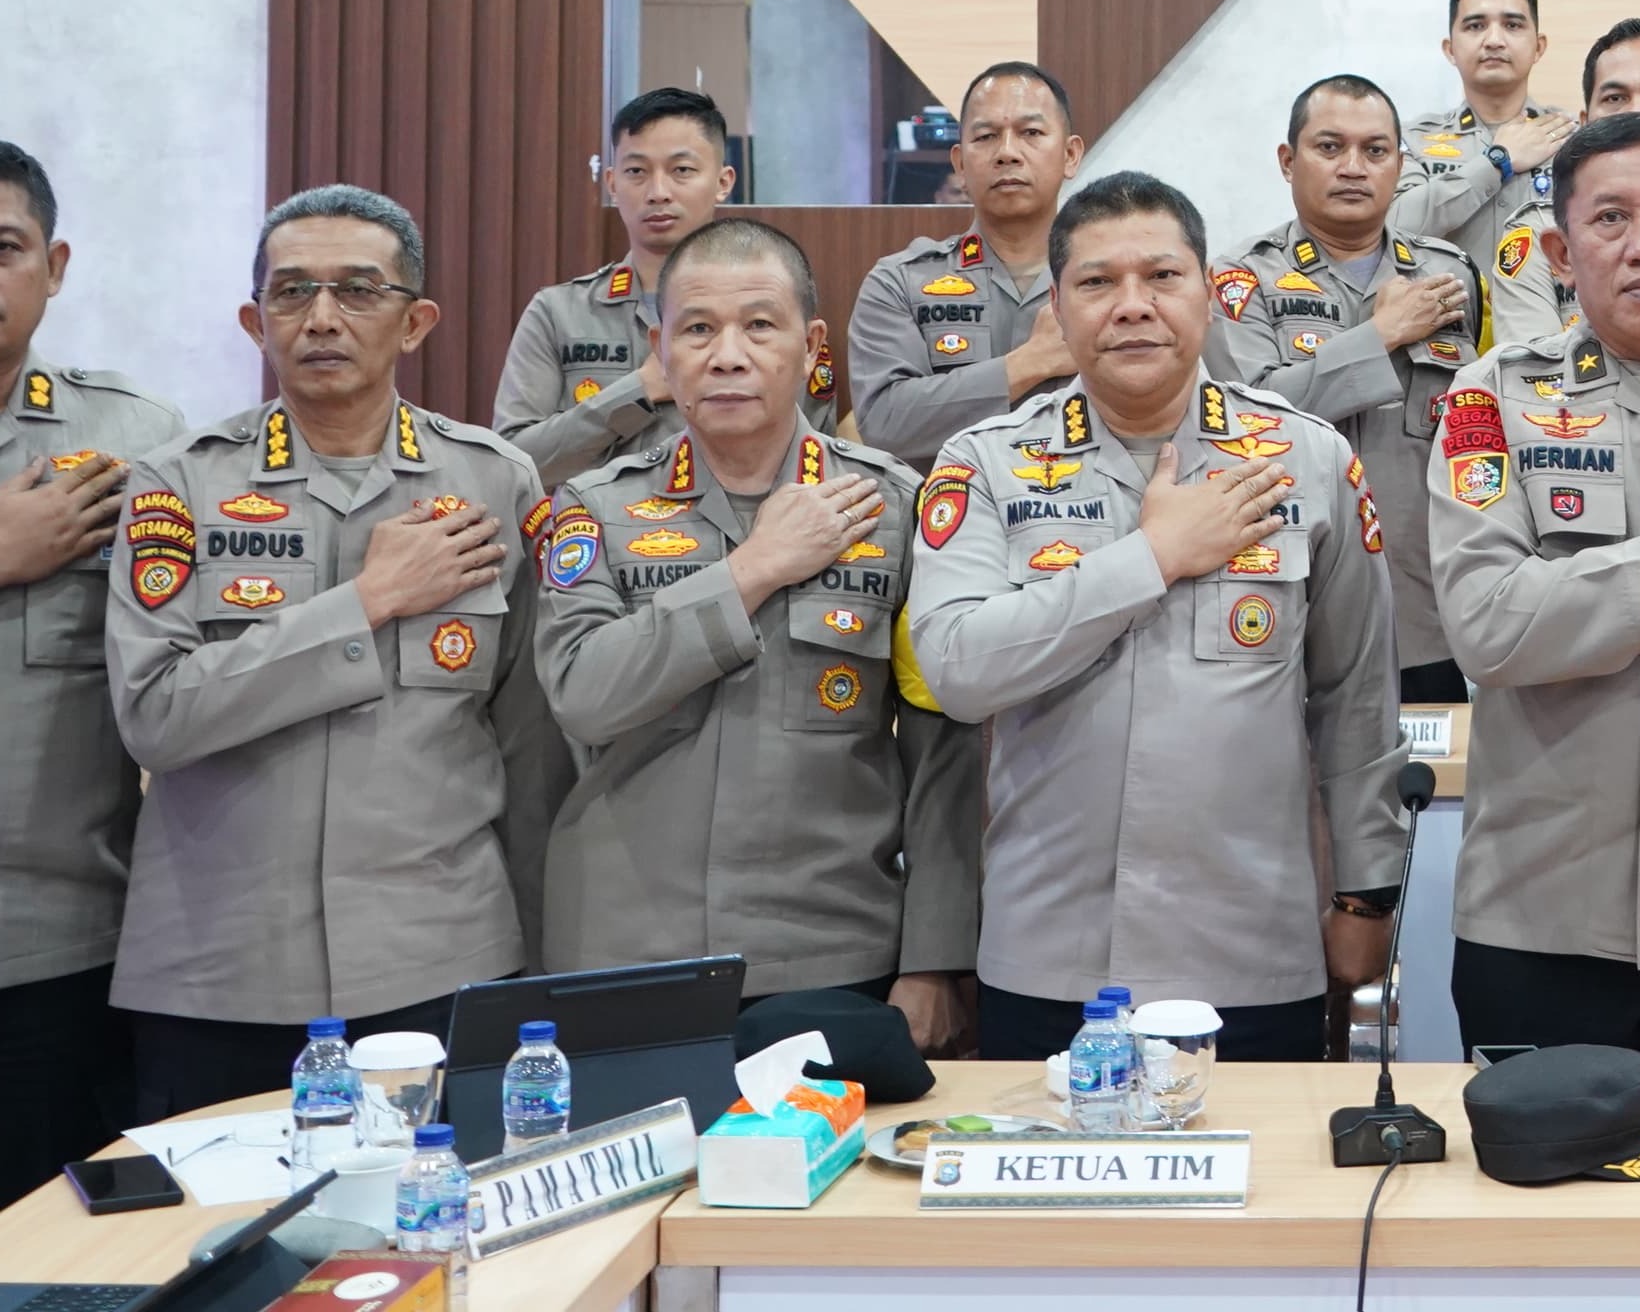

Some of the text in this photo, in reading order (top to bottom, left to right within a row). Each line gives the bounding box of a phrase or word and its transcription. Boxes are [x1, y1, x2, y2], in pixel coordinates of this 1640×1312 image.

[918, 304, 985, 325] ROBET
[1450, 410, 1504, 427] GEGAN
[1447, 433, 1508, 452] PELOPO
[1518, 445, 1615, 473] HERMAN
[1007, 499, 1105, 528] MIRZAL ALWI
[130, 520, 197, 548] DITSAMAPTA
[207, 530, 304, 559] DUDUS
[618, 564, 706, 593] R.A.KASEN
[820, 568, 890, 598] OLRI
[494, 1131, 665, 1227] PAMATWIL
[995, 1154, 1215, 1181] KETUA TIM
